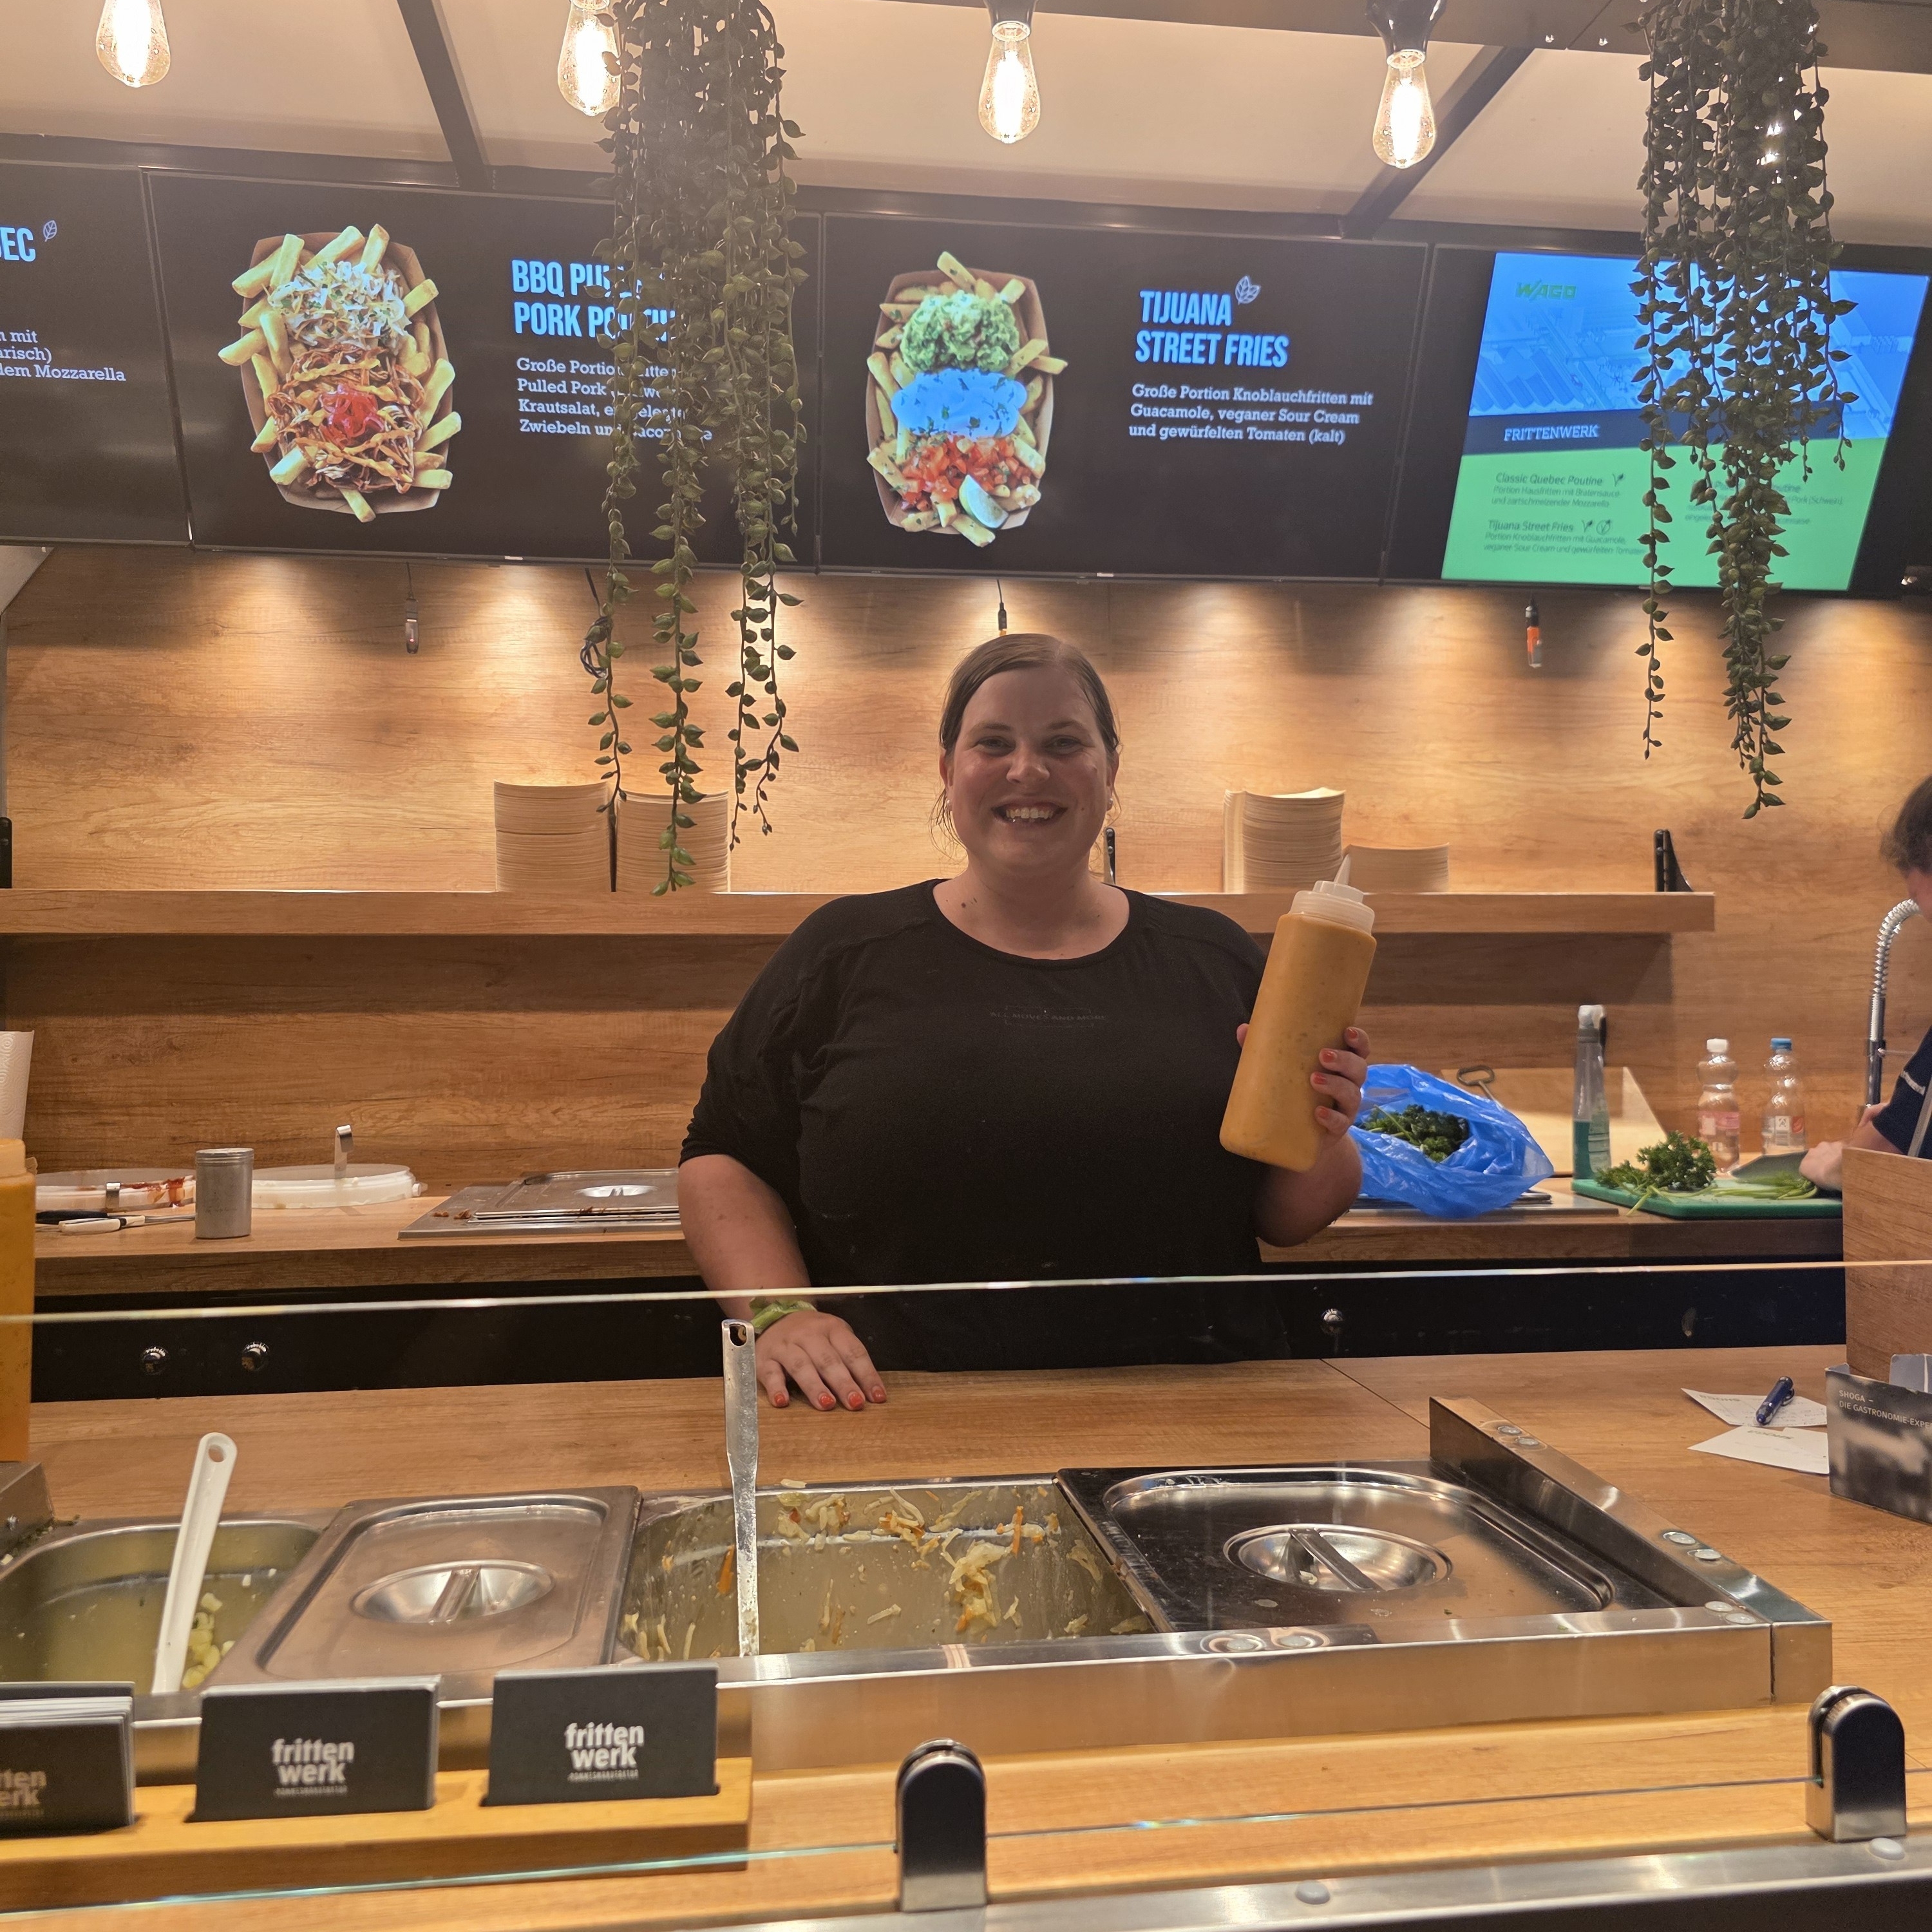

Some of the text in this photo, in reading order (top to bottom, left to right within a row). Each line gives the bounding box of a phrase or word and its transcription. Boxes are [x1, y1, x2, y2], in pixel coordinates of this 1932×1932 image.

[0, 227, 36, 261] EC
[512, 260, 564, 297] BBQ
[1516, 279, 1577, 301] WAGO
[1140, 291, 1231, 326] TIJUANA
[514, 302, 582, 337] PORK
[10, 329, 38, 343] mit
[1135, 330, 1289, 367] STREET FRIES
[33, 364, 126, 381] Mozzarella
[516, 357, 565, 372] Große
[517, 378, 567, 393] Pulled
[571, 381, 607, 395] Pork
[1132, 383, 1373, 405] Große Portion Knoblauchfritten mit
[518, 399, 600, 417] Krautsalat,
[1131, 403, 1359, 424] Guacamole, veganer Sour Cream
[520, 419, 591, 435] Zwiebeln
[1129, 424, 1345, 445] und gewürfelten Tomaten (kalt)
[1504, 424, 1599, 442] FRITTENWERK
[1495, 472, 1603, 486] Classic Quebec Poutine
[1488, 519, 1574, 533] Tijuana Street Fries
[1839, 1390, 1865, 1402] SHOGA
[1839, 1400, 1851, 1410] DIE
[564, 1722, 645, 1750] fritten
[271, 1738, 355, 1765] fritten
[571, 1741, 638, 1771] werk
[278, 1759, 346, 1786] werk
